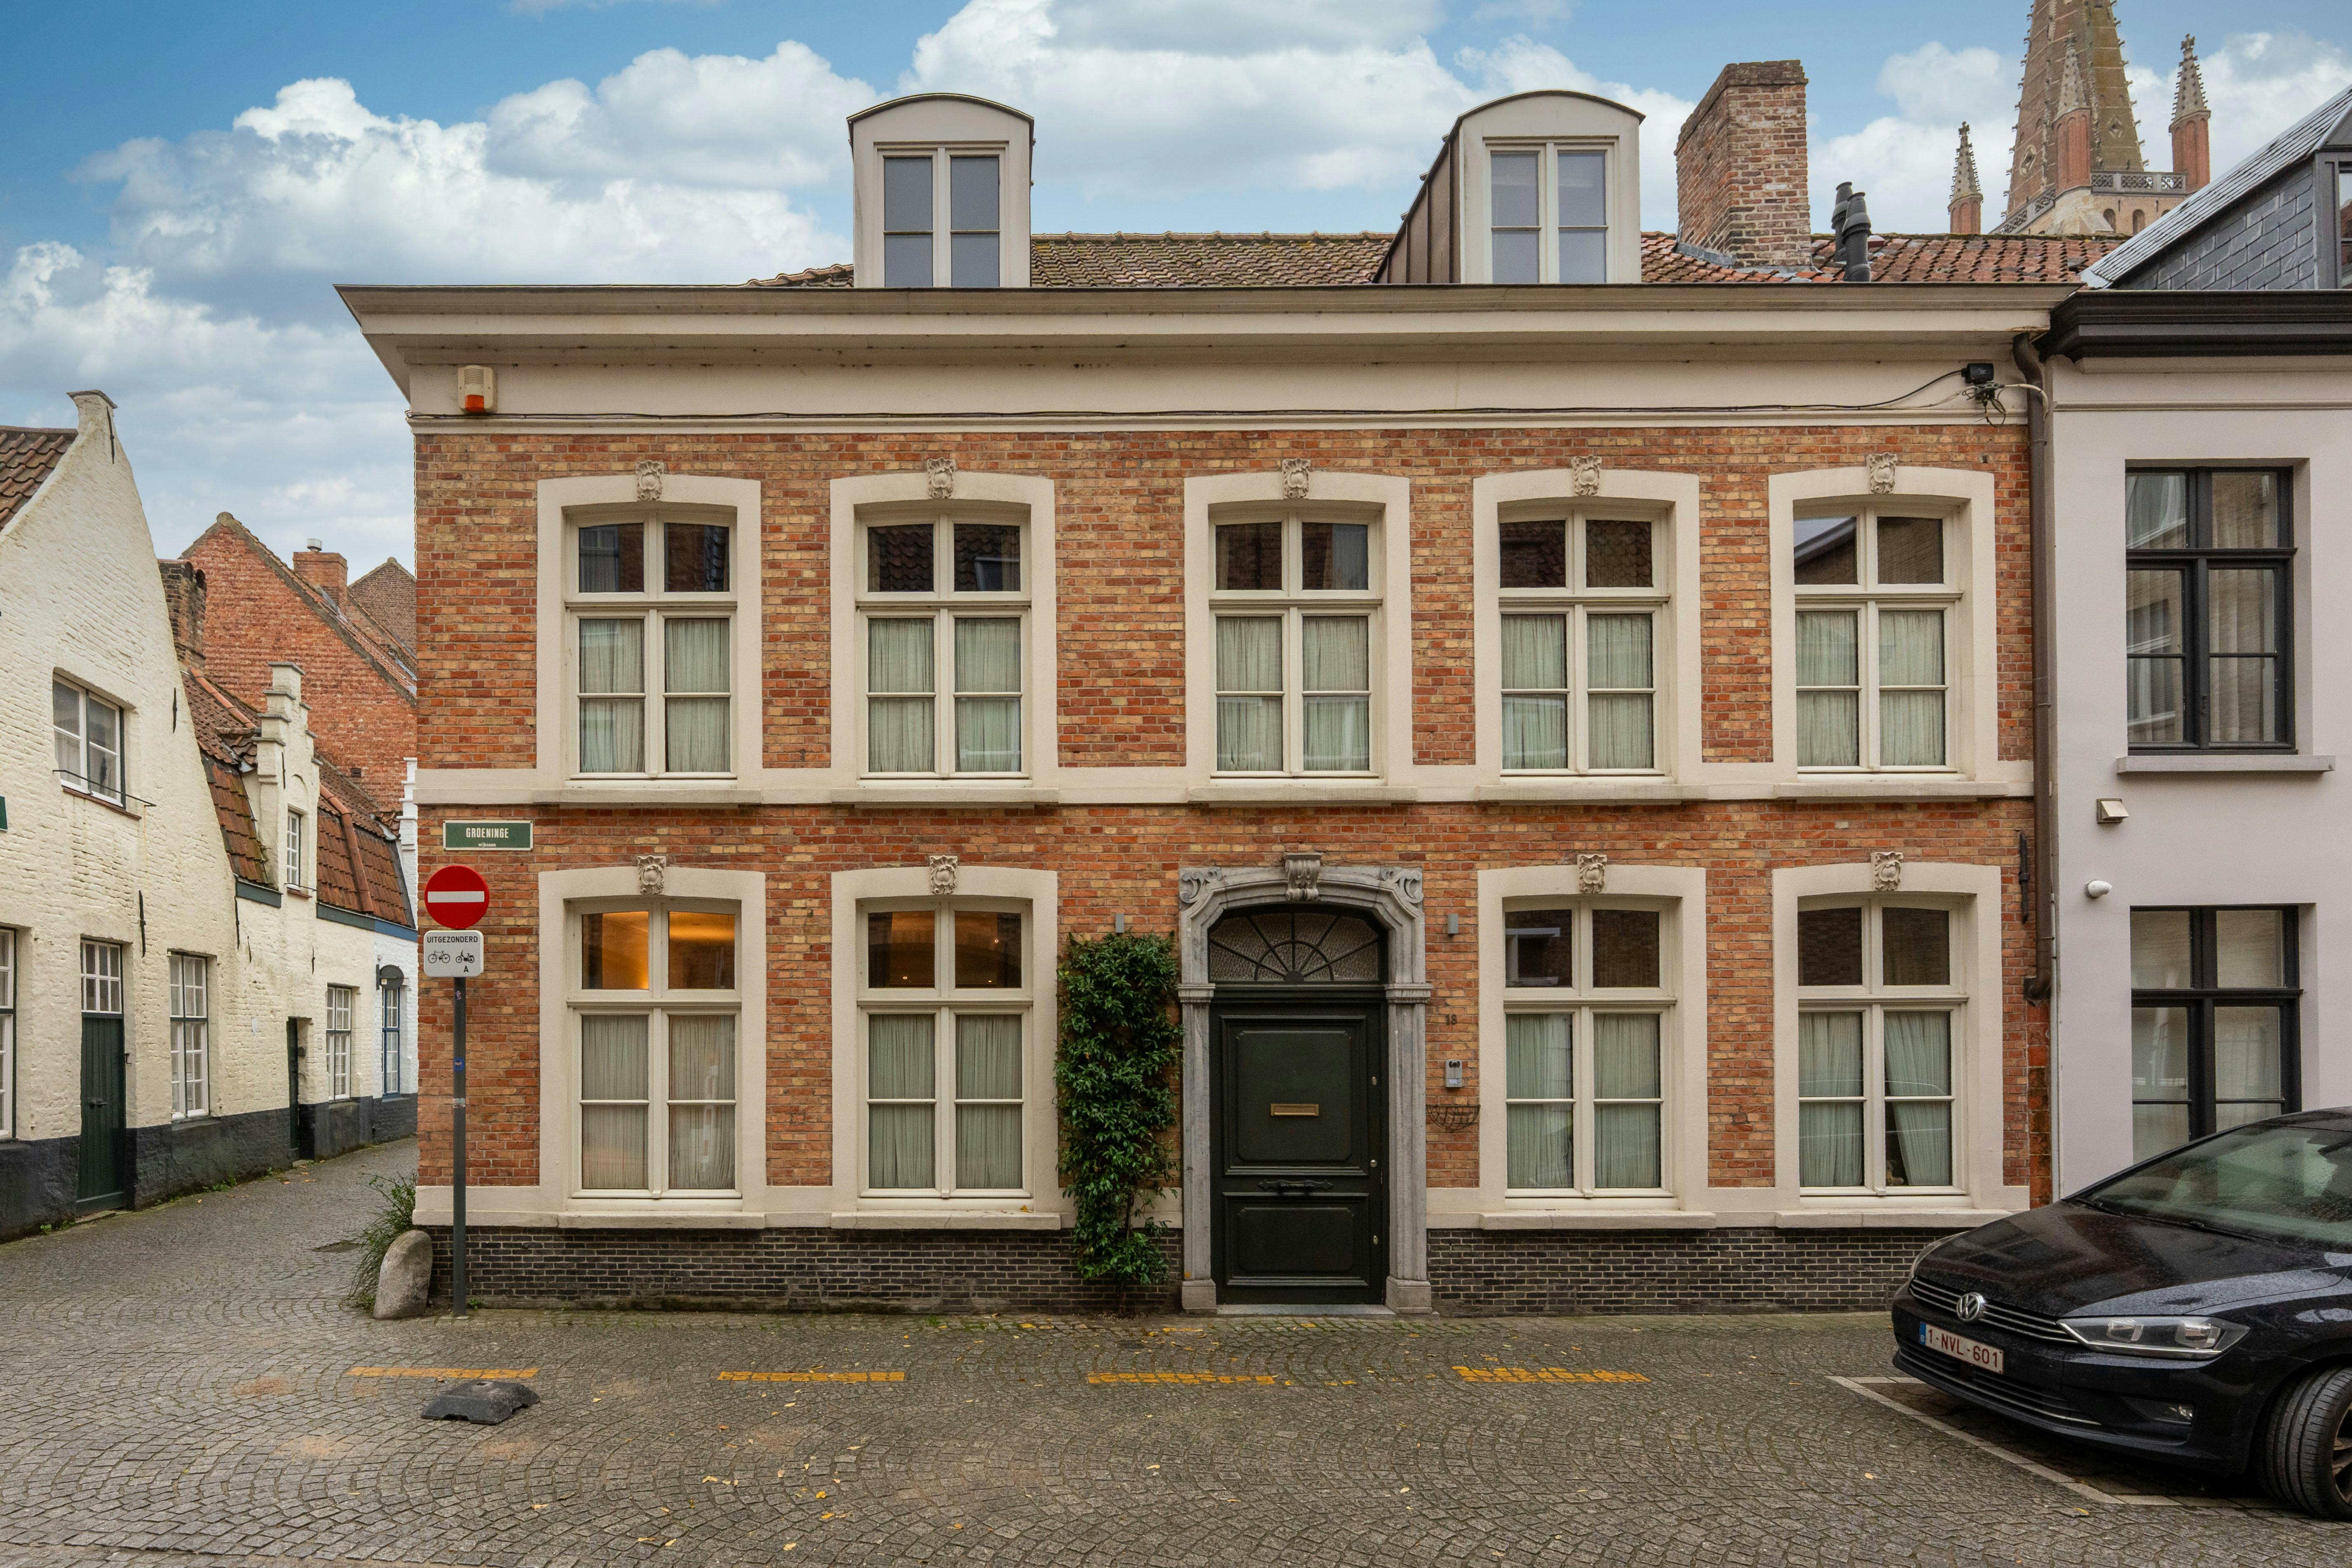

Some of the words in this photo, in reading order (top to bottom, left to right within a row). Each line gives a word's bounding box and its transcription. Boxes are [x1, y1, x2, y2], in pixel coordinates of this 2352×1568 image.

[466, 827, 509, 838] GROENINGE
[1445, 1014, 1457, 1025] 18
[1928, 1329, 1998, 1368] 1-NVL-601
